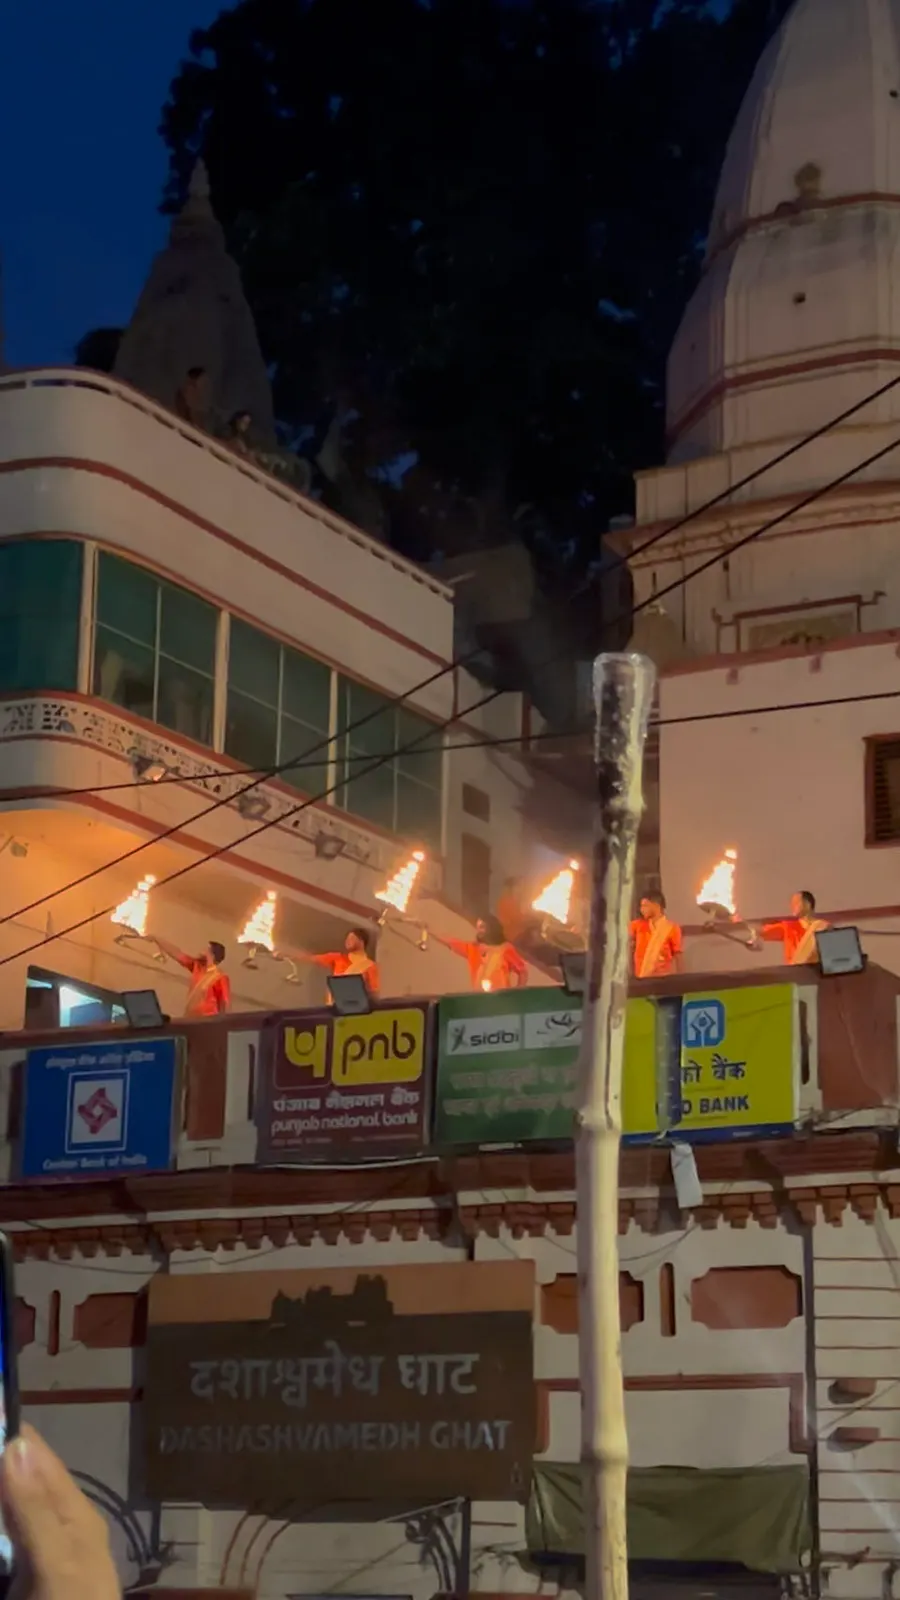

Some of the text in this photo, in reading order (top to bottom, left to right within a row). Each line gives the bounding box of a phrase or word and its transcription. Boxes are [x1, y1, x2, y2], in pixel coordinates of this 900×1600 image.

[341, 1019, 416, 1076] pnb
[470, 1029, 519, 1047] sidbi
[273, 1094, 321, 1112] पंजाब
[699, 1095, 749, 1115] BANK
[271, 1109, 418, 1137] punjab national bank
[397, 1352, 480, 1395] घाट
[159, 1420, 513, 1454] DASHASHVAMEDH GHAT
